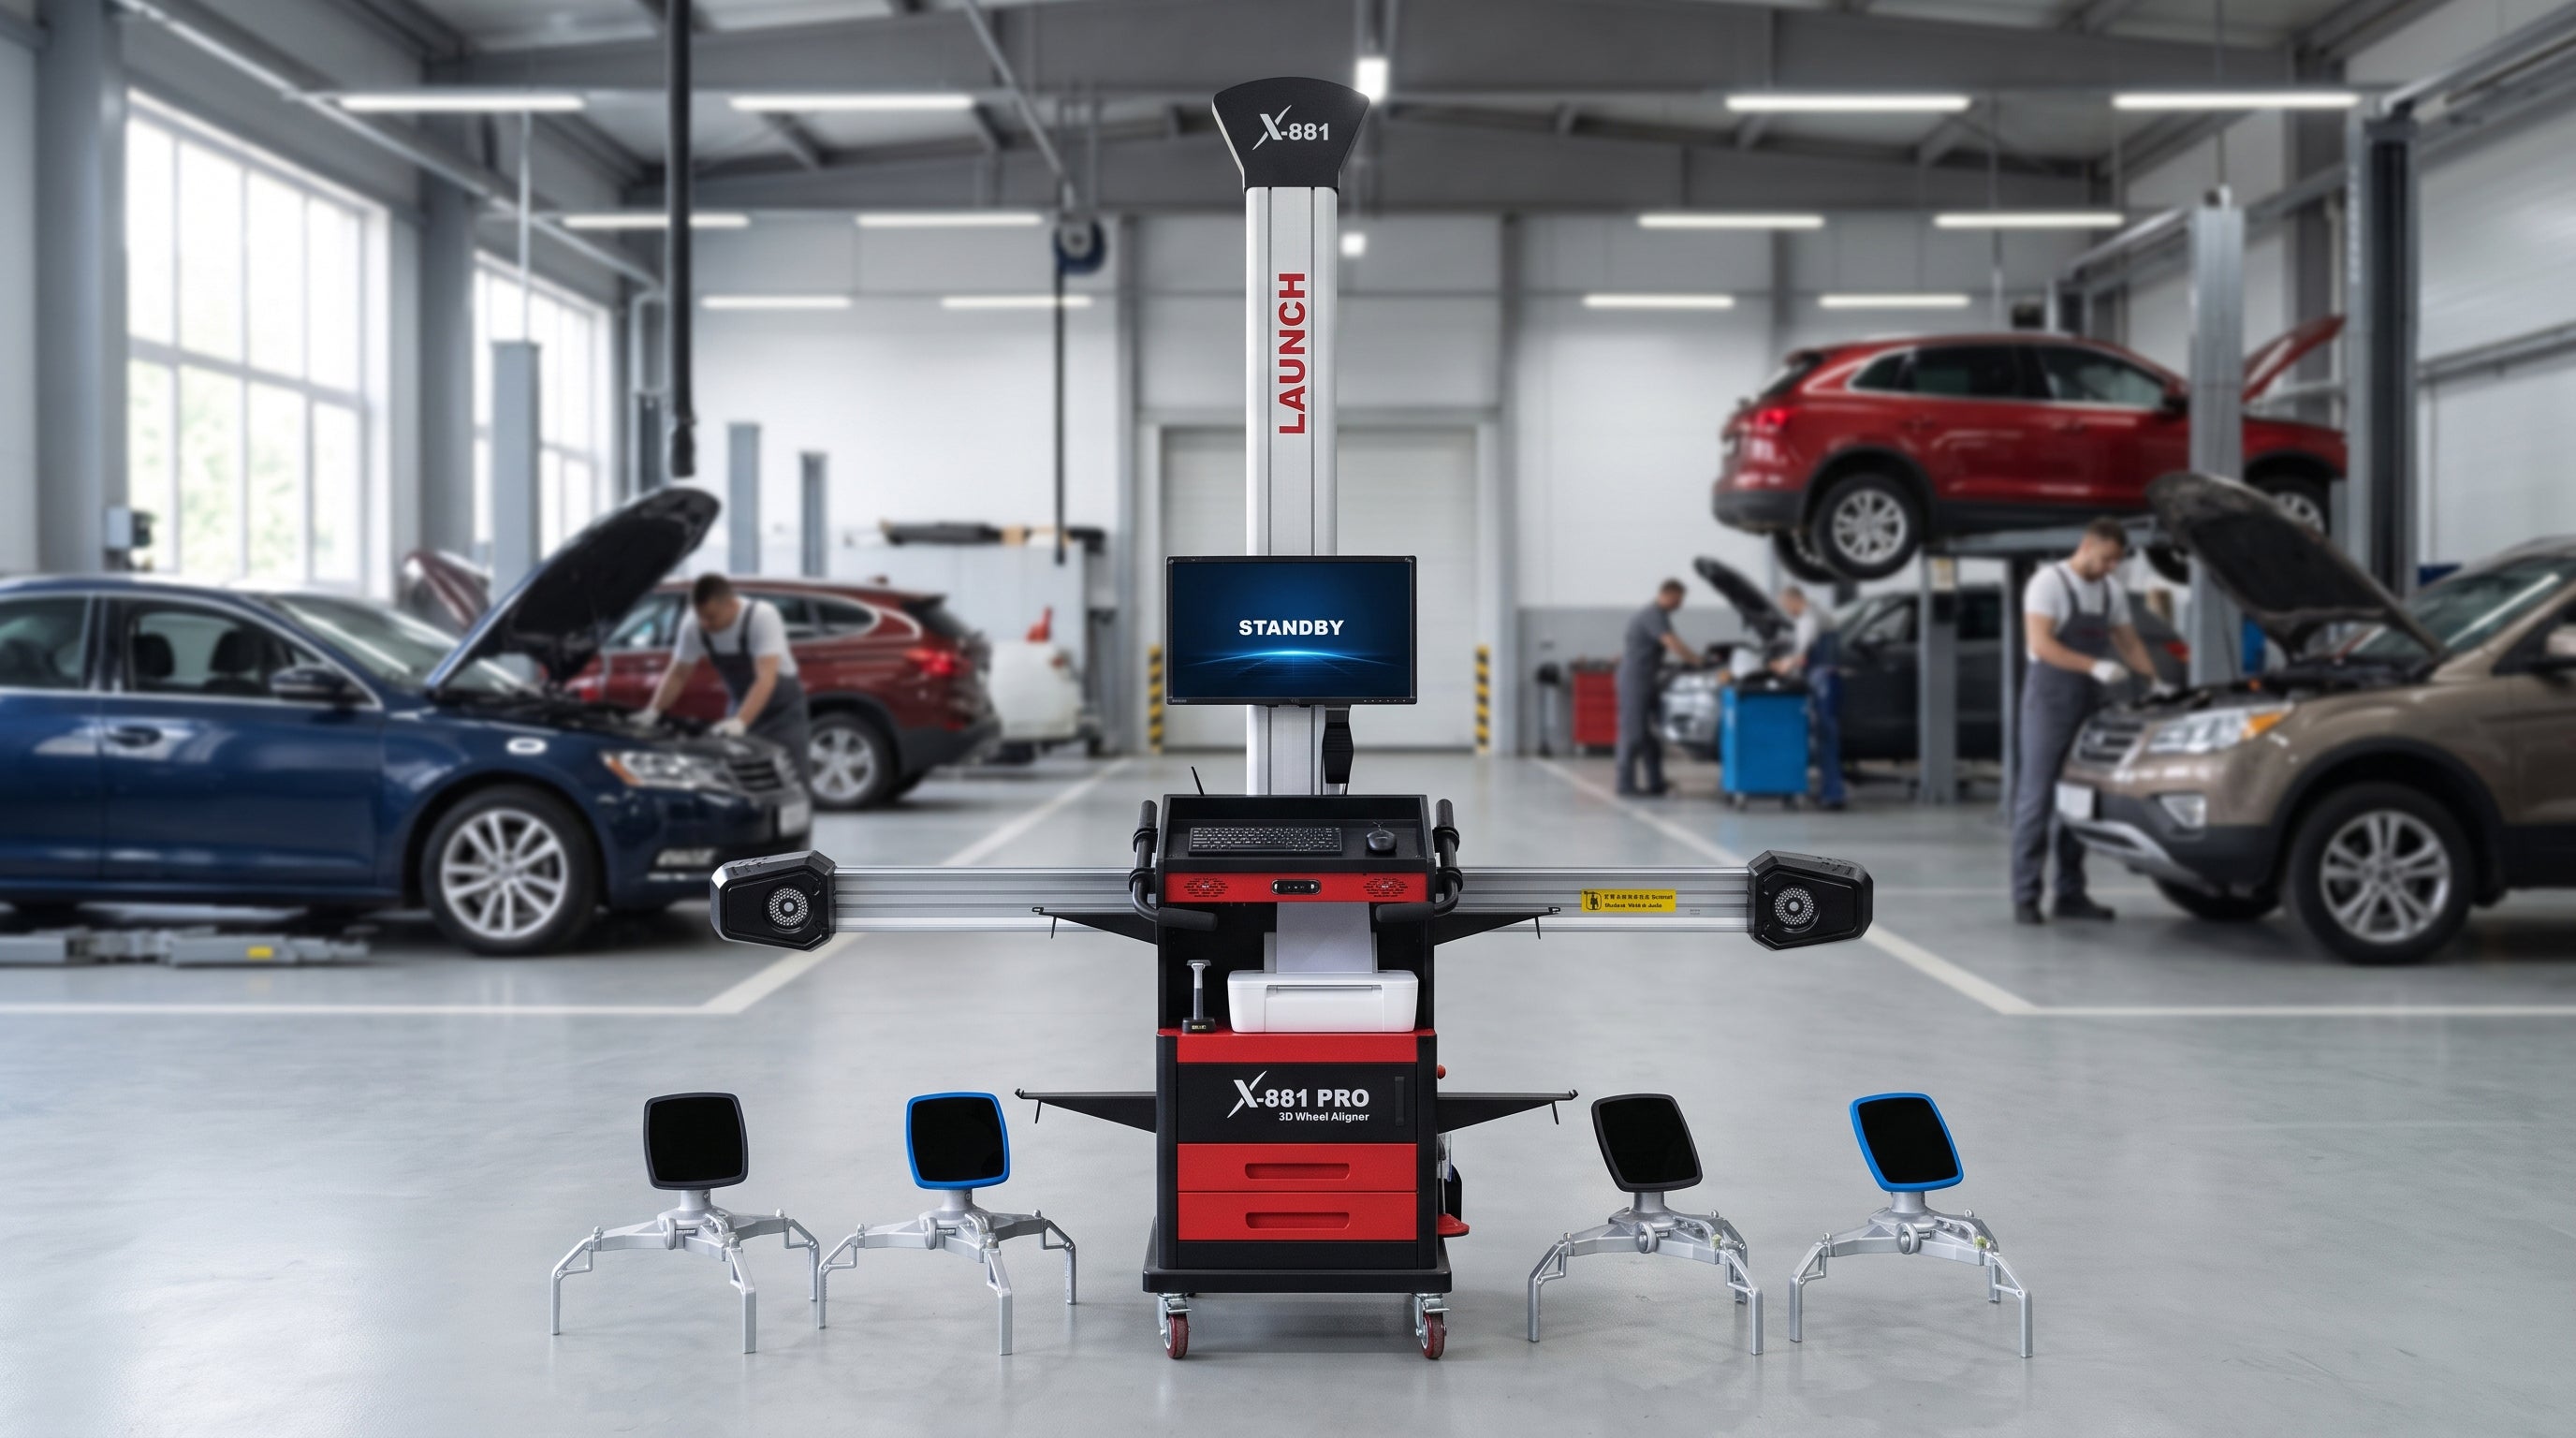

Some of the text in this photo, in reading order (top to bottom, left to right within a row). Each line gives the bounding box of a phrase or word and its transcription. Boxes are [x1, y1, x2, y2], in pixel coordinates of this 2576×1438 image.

[1252, 105, 1329, 151] X-881
[1279, 273, 1306, 434] LAUNCH
[1238, 619, 1345, 636] STANDBY
[1227, 1070, 1369, 1119] X-881 PRO
[1279, 1111, 1370, 1123] 3D Wheel Aligner
